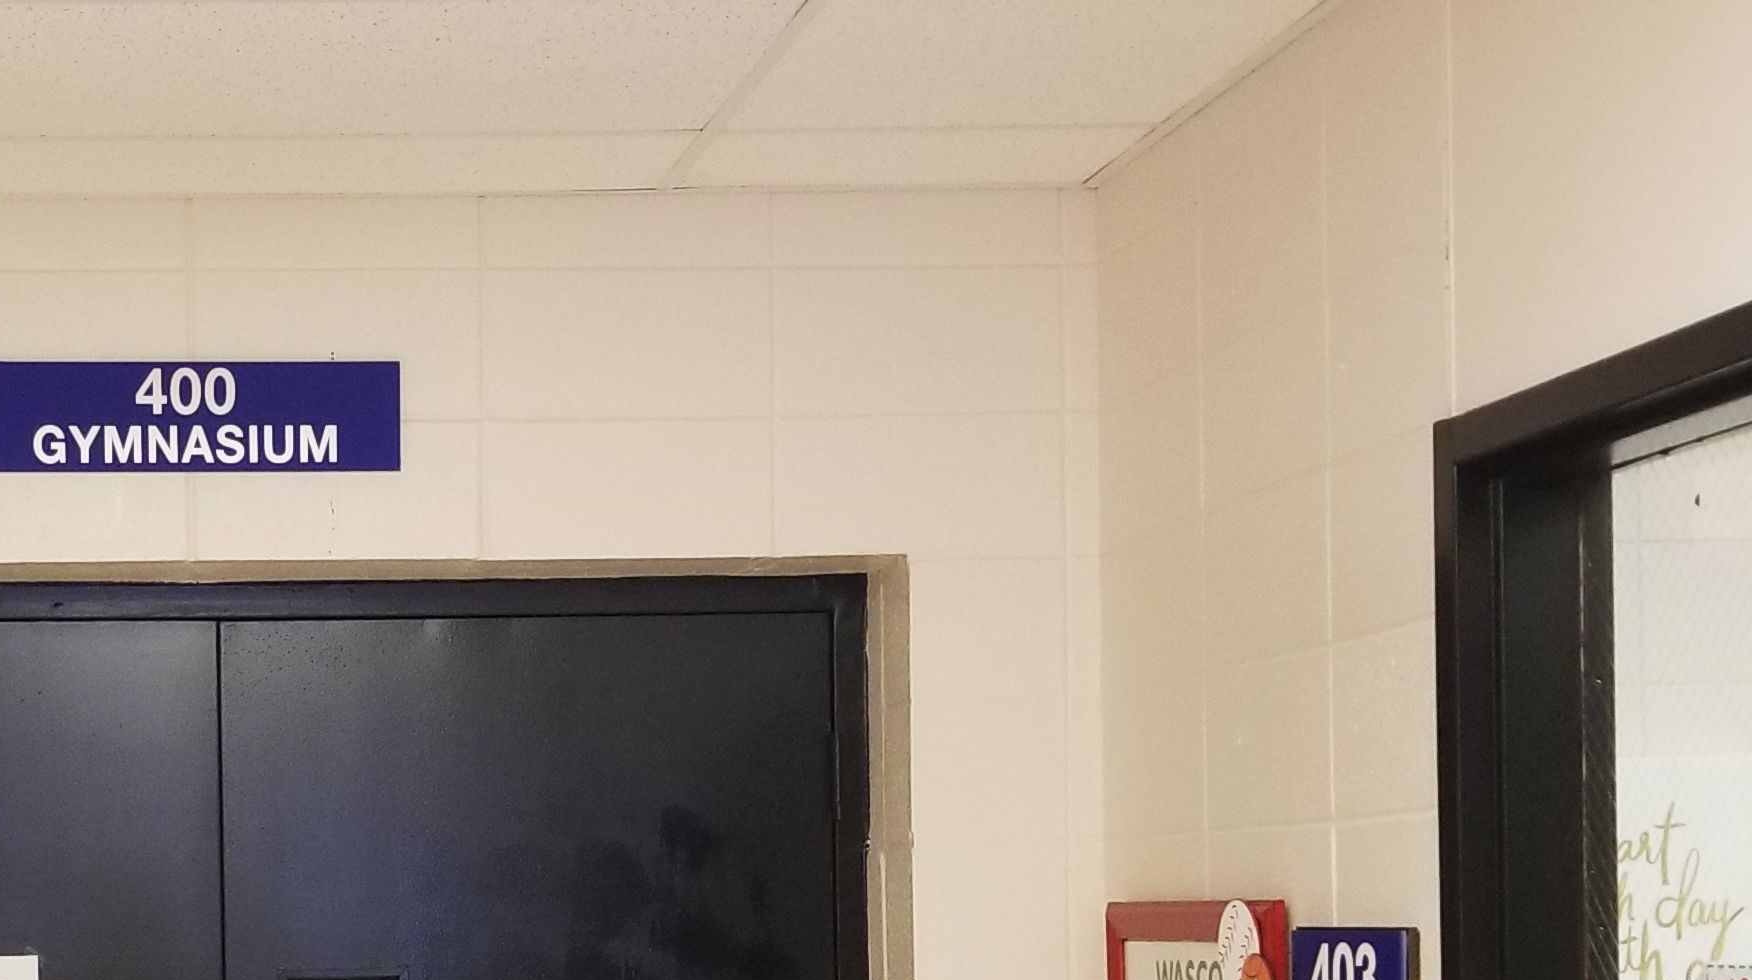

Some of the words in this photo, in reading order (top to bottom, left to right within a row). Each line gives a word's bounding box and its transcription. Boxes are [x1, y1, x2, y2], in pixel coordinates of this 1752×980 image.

[135, 366, 236, 416] 400
[32, 423, 338, 465] GYMNASIUM
[1617, 801, 1687, 886] art
[1655, 847, 1745, 962] day
